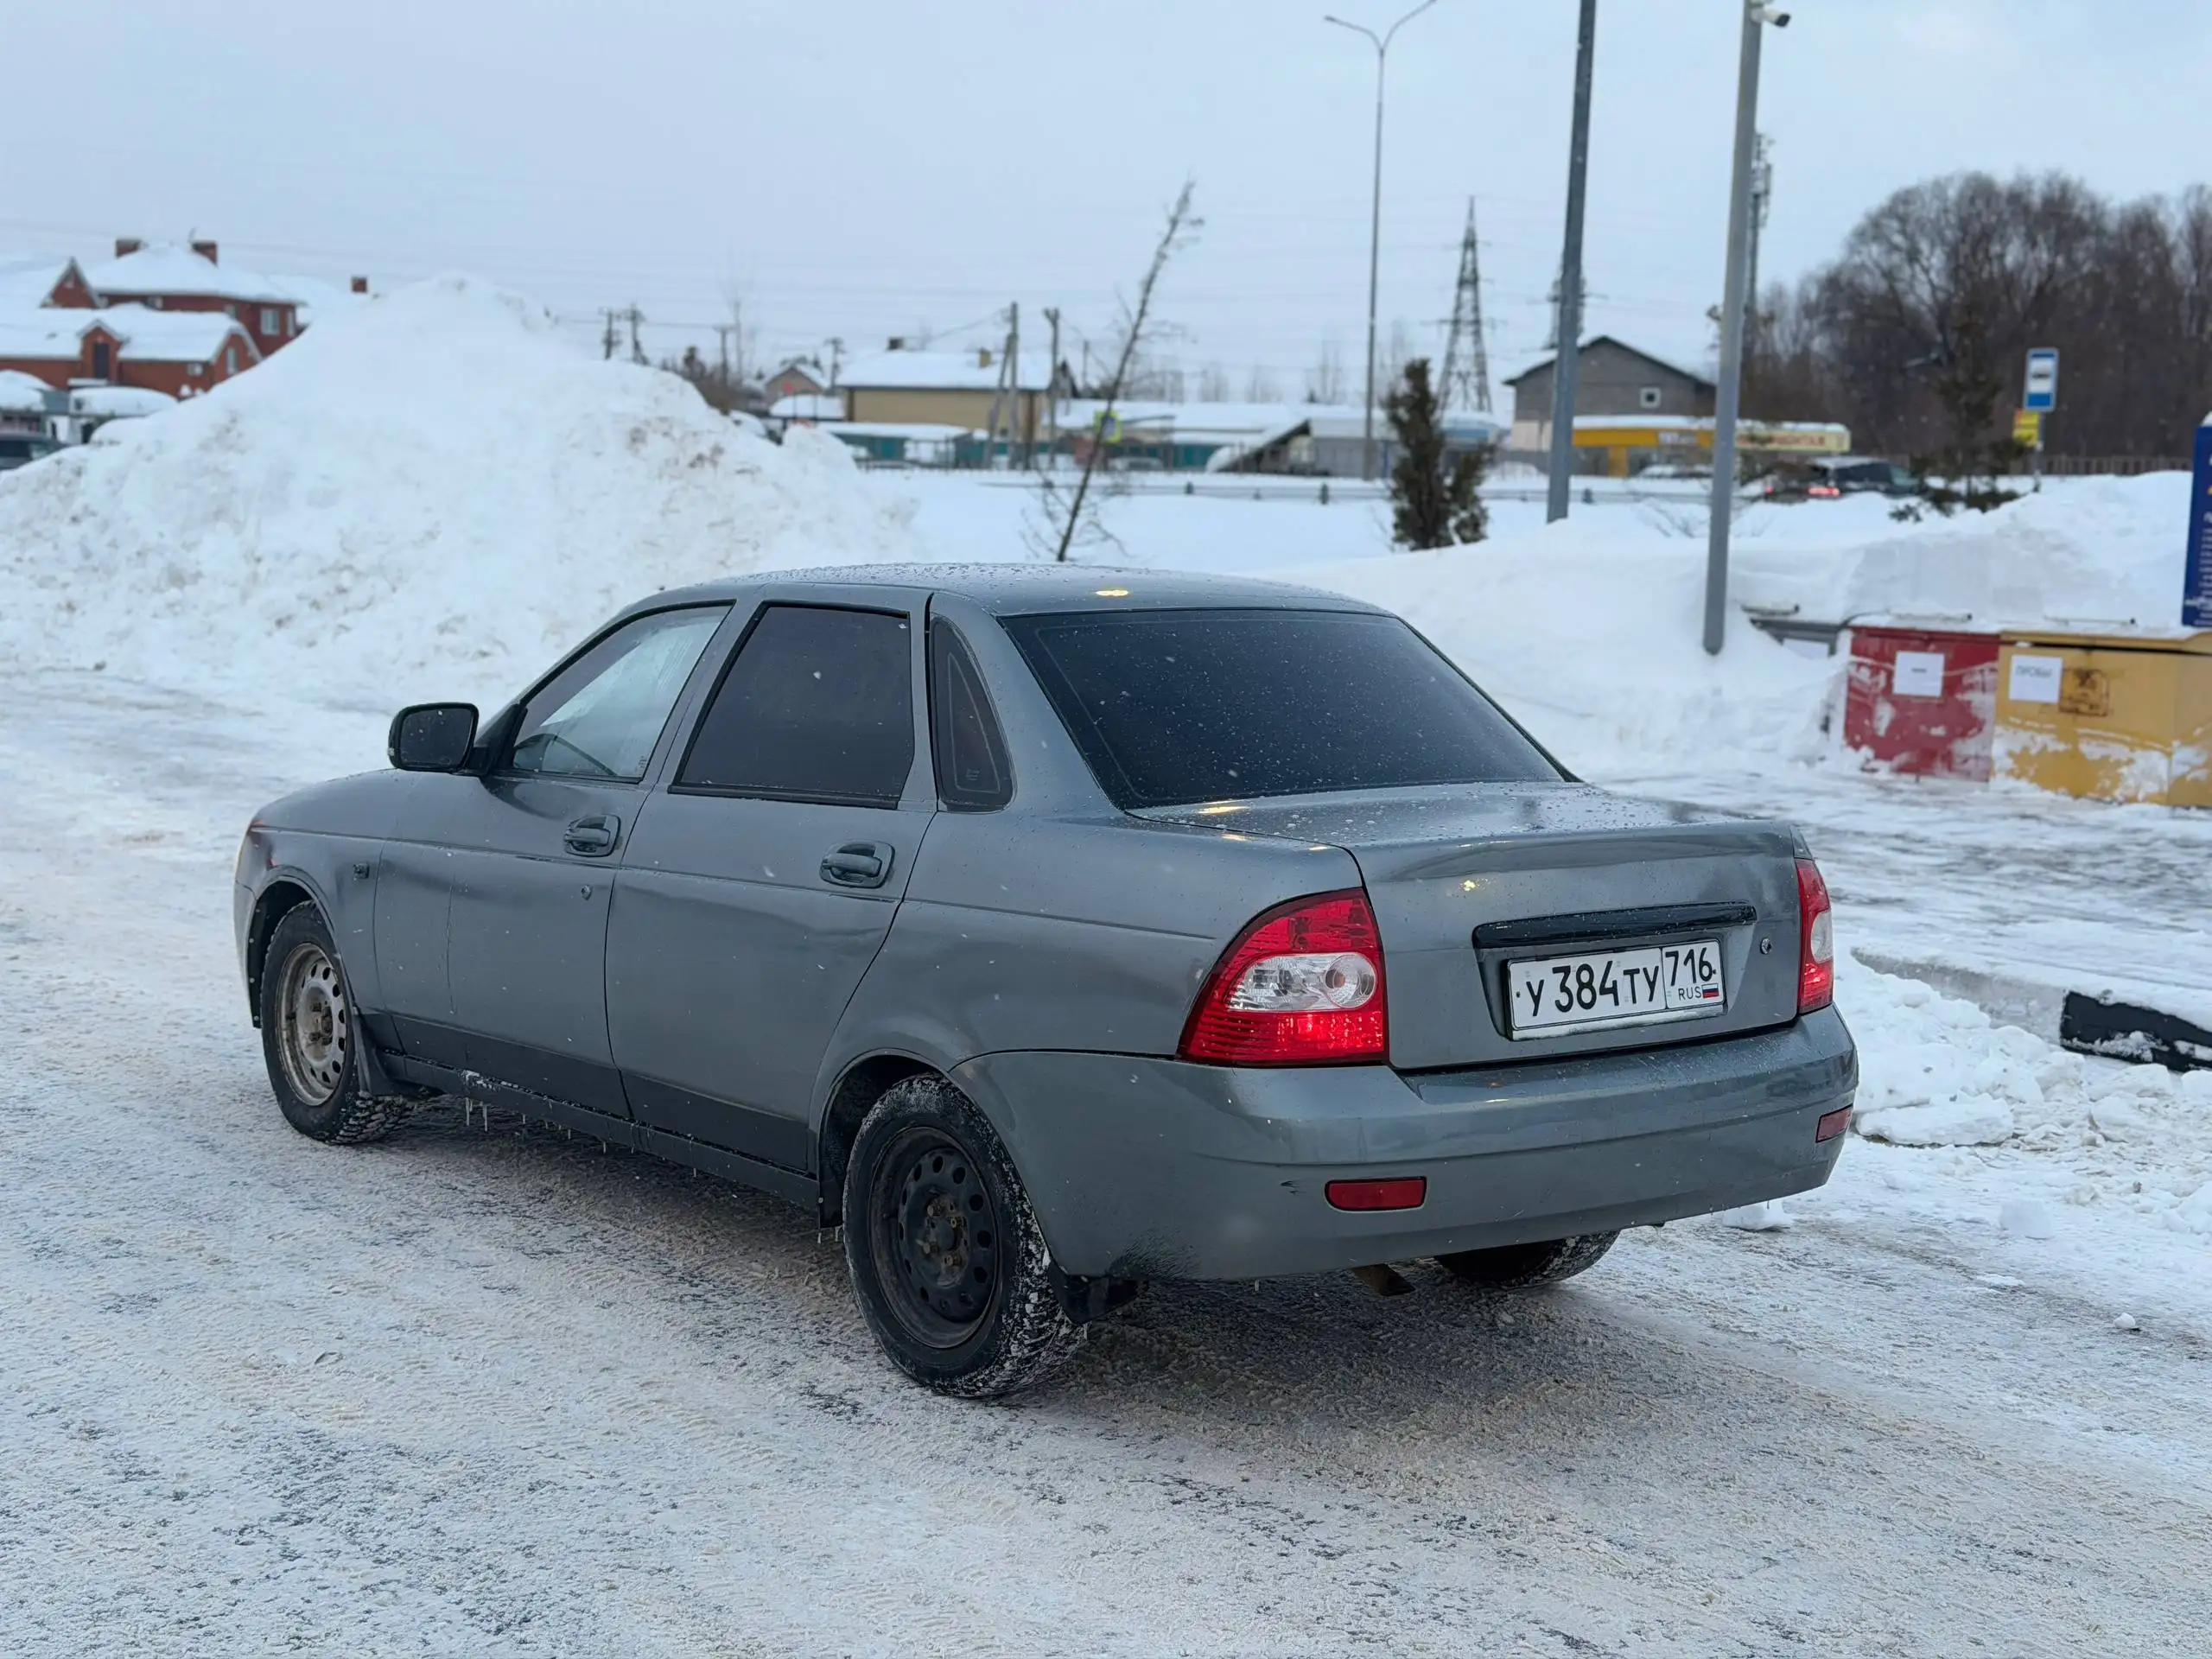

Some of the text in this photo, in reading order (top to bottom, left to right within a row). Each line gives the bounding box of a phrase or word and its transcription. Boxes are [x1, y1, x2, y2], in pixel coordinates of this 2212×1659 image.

[1665, 947, 1712, 986] 716
[1526, 960, 1659, 1017] У384ТУ
[1679, 988, 1701, 1001] RUS
